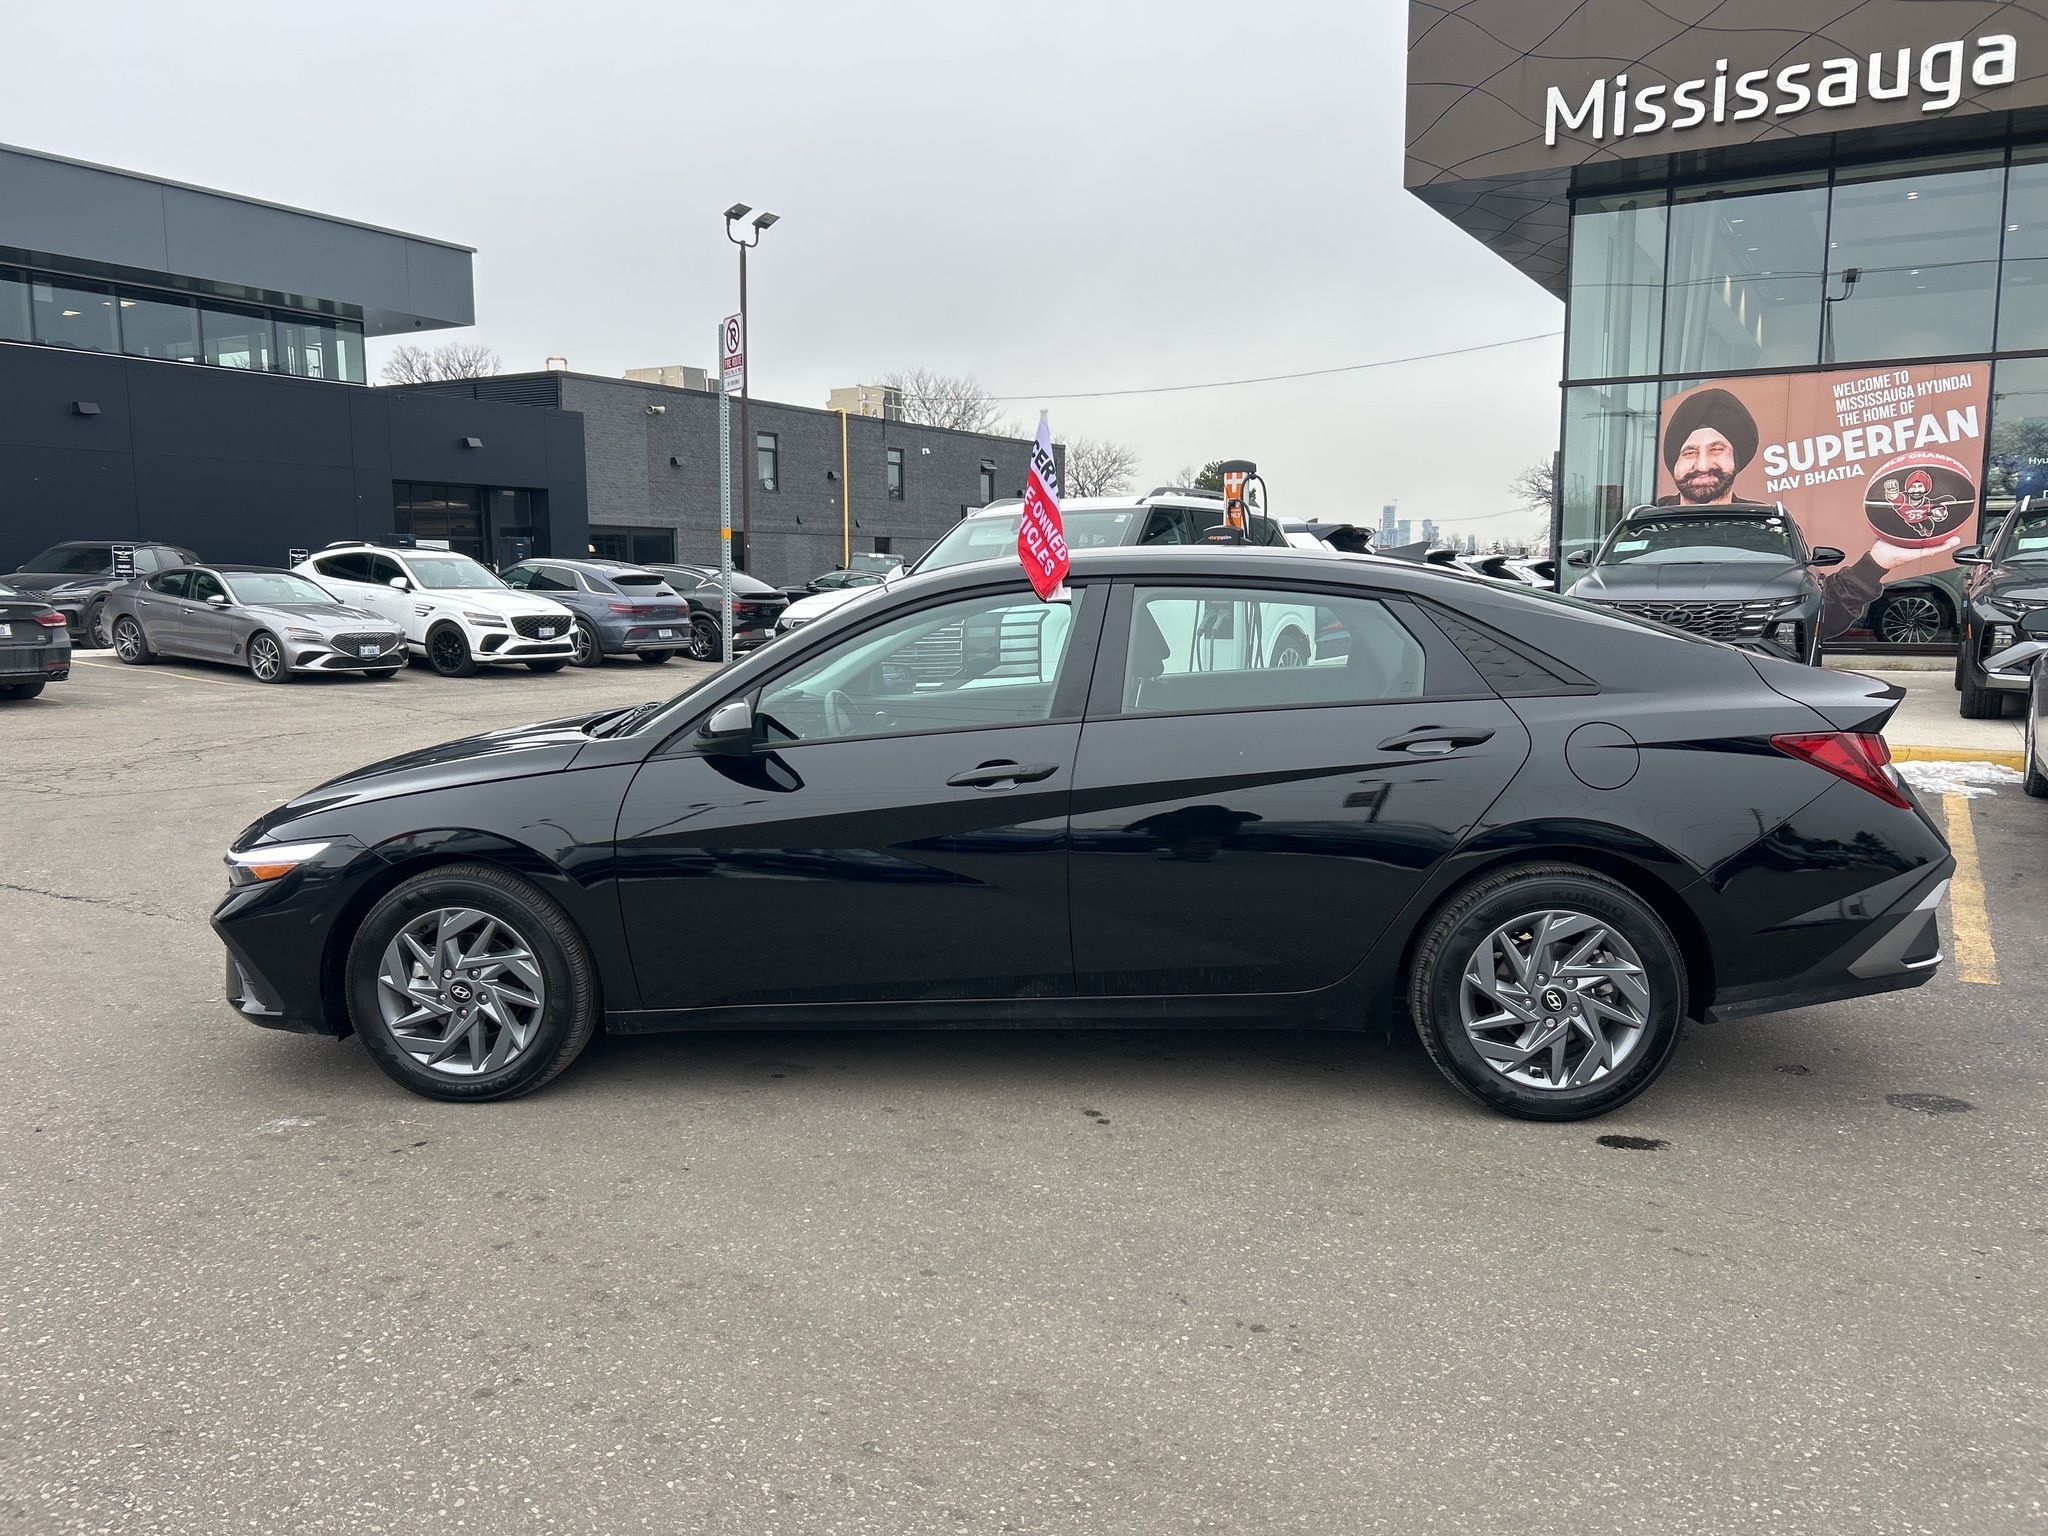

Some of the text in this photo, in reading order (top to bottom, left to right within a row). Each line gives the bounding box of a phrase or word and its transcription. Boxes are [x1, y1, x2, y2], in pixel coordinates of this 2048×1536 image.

[1544, 33, 2017, 147] Mississauga
[1833, 370, 1910, 398] WELCOME TO
[1835, 373, 1972, 414] MISSISSAUGA HYUNDAI
[1837, 400, 1915, 428] THE HOME OF
[1763, 405, 1979, 476] SUPERFAN
[1766, 463, 1865, 493] NAV BHATIA
